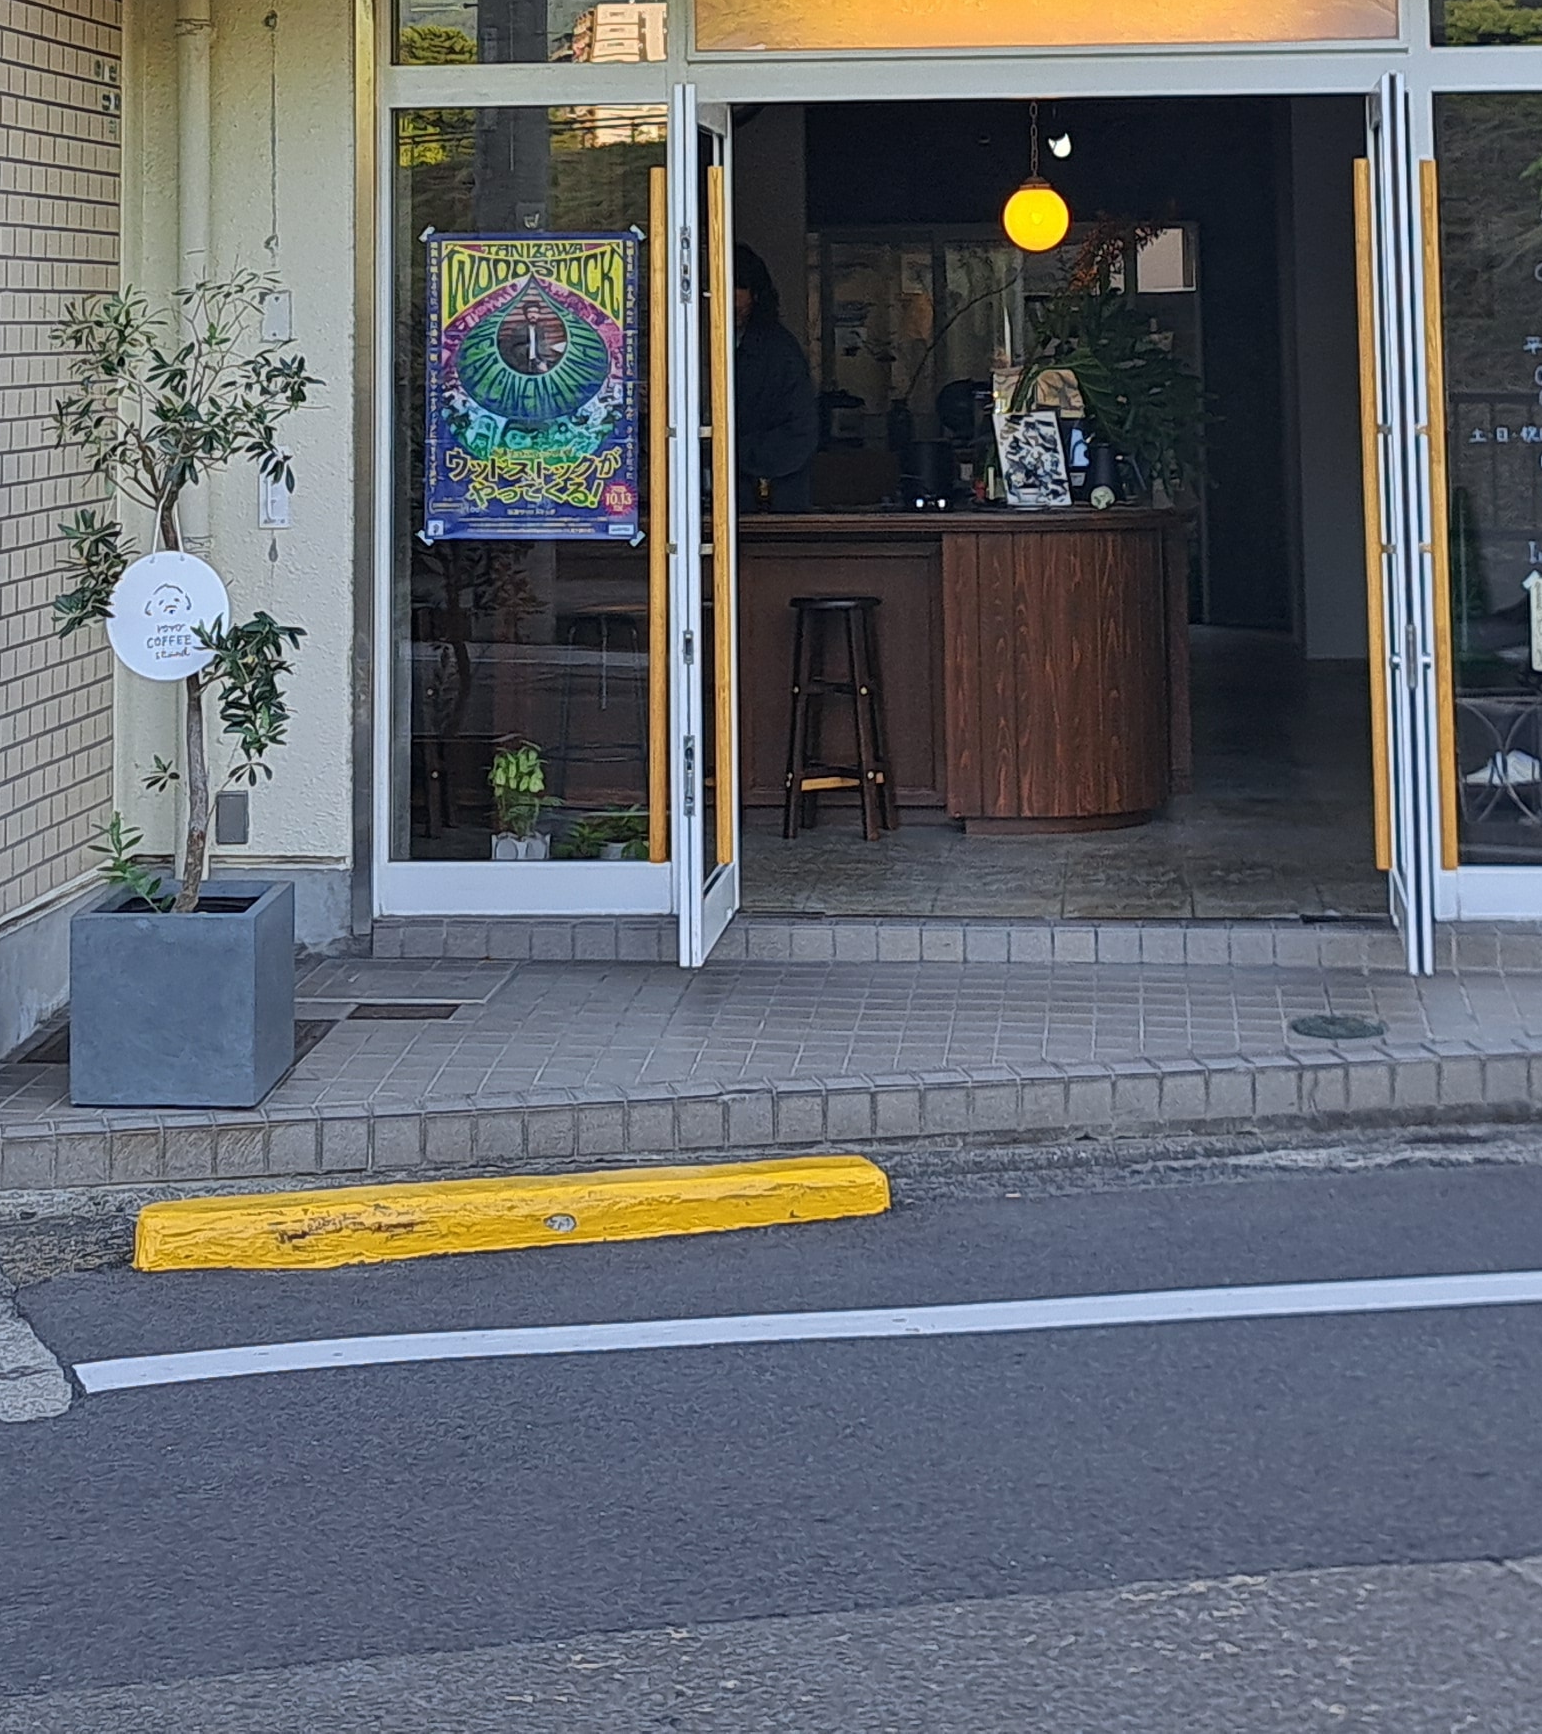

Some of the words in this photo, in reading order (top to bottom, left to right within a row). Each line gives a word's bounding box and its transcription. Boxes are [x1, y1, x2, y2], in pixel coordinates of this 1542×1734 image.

[481, 242, 585, 259] TANIZAWA
[446, 244, 622, 322] WOODSTOCK
[446, 446, 622, 482] ウッドストックが
[146, 634, 192, 649] COFFEE
[155, 646, 191, 660] stand
